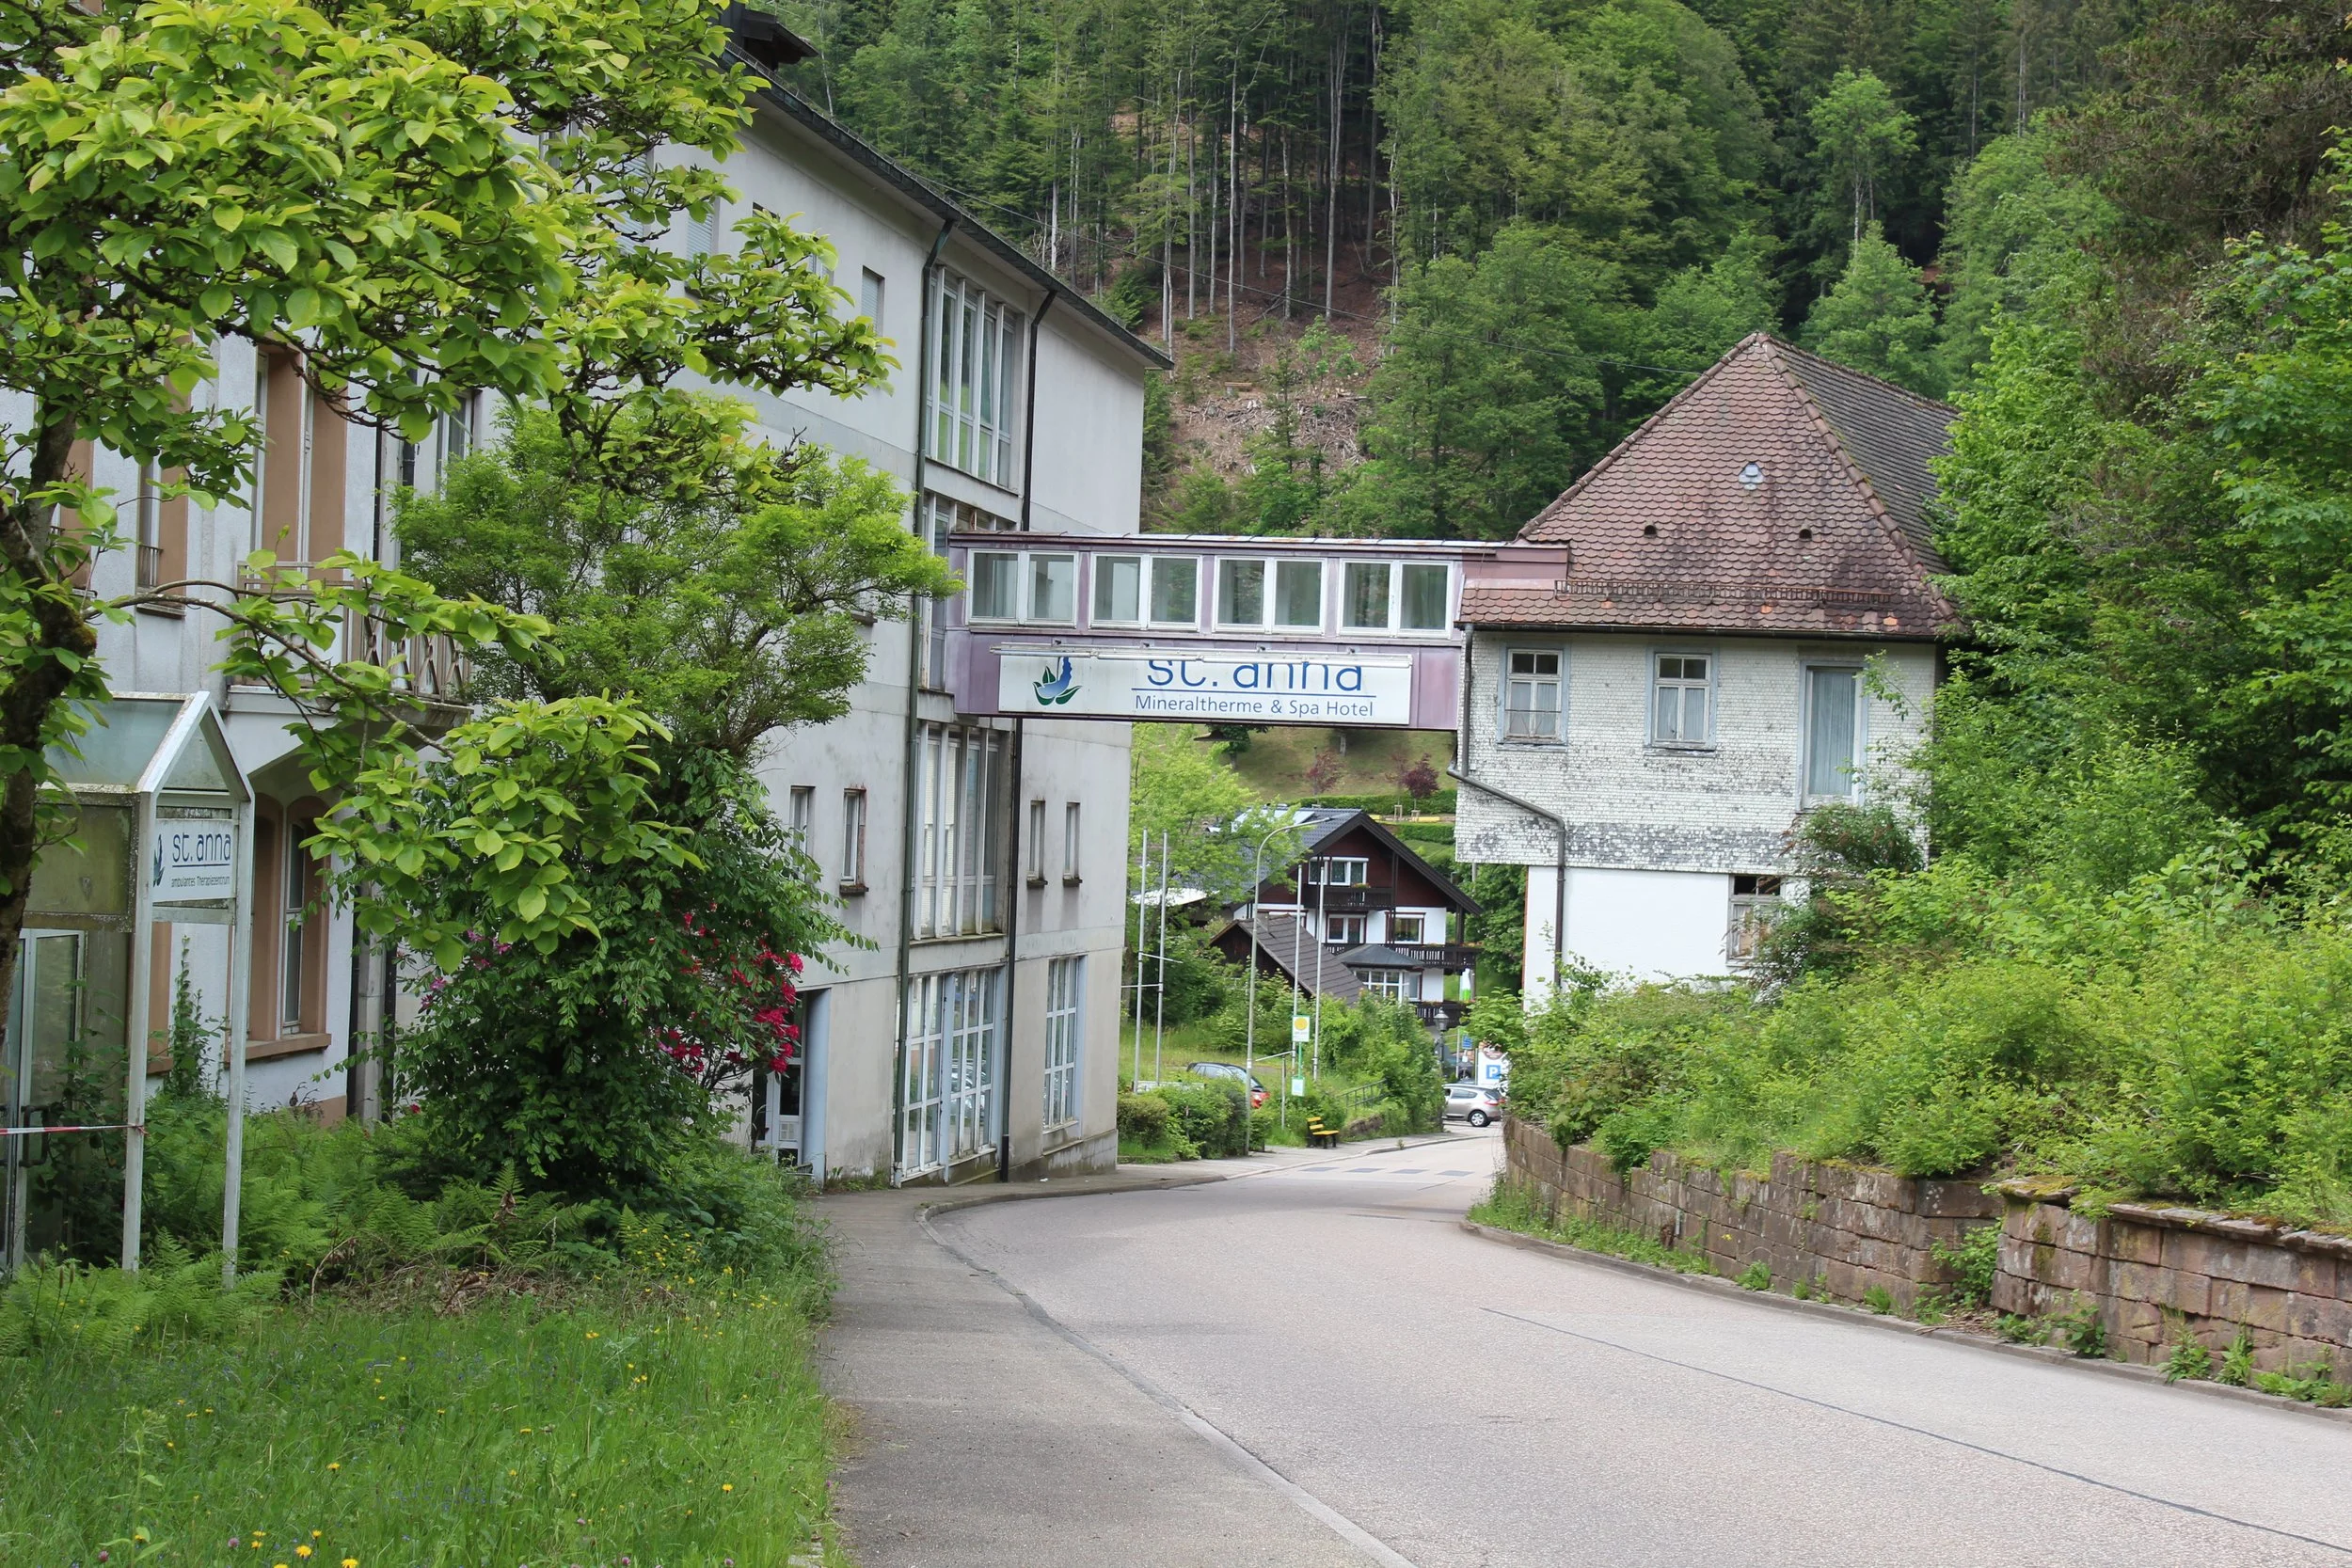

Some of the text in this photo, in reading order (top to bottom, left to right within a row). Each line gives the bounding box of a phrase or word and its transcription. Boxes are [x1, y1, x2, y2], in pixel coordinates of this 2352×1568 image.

[1232, 661, 1362, 691] anna
[1136, 695, 1374, 718] Mineraltherme & Spa Hotel
[172, 832, 231, 863] st. anna
[1489, 1067, 1498, 1077] P
